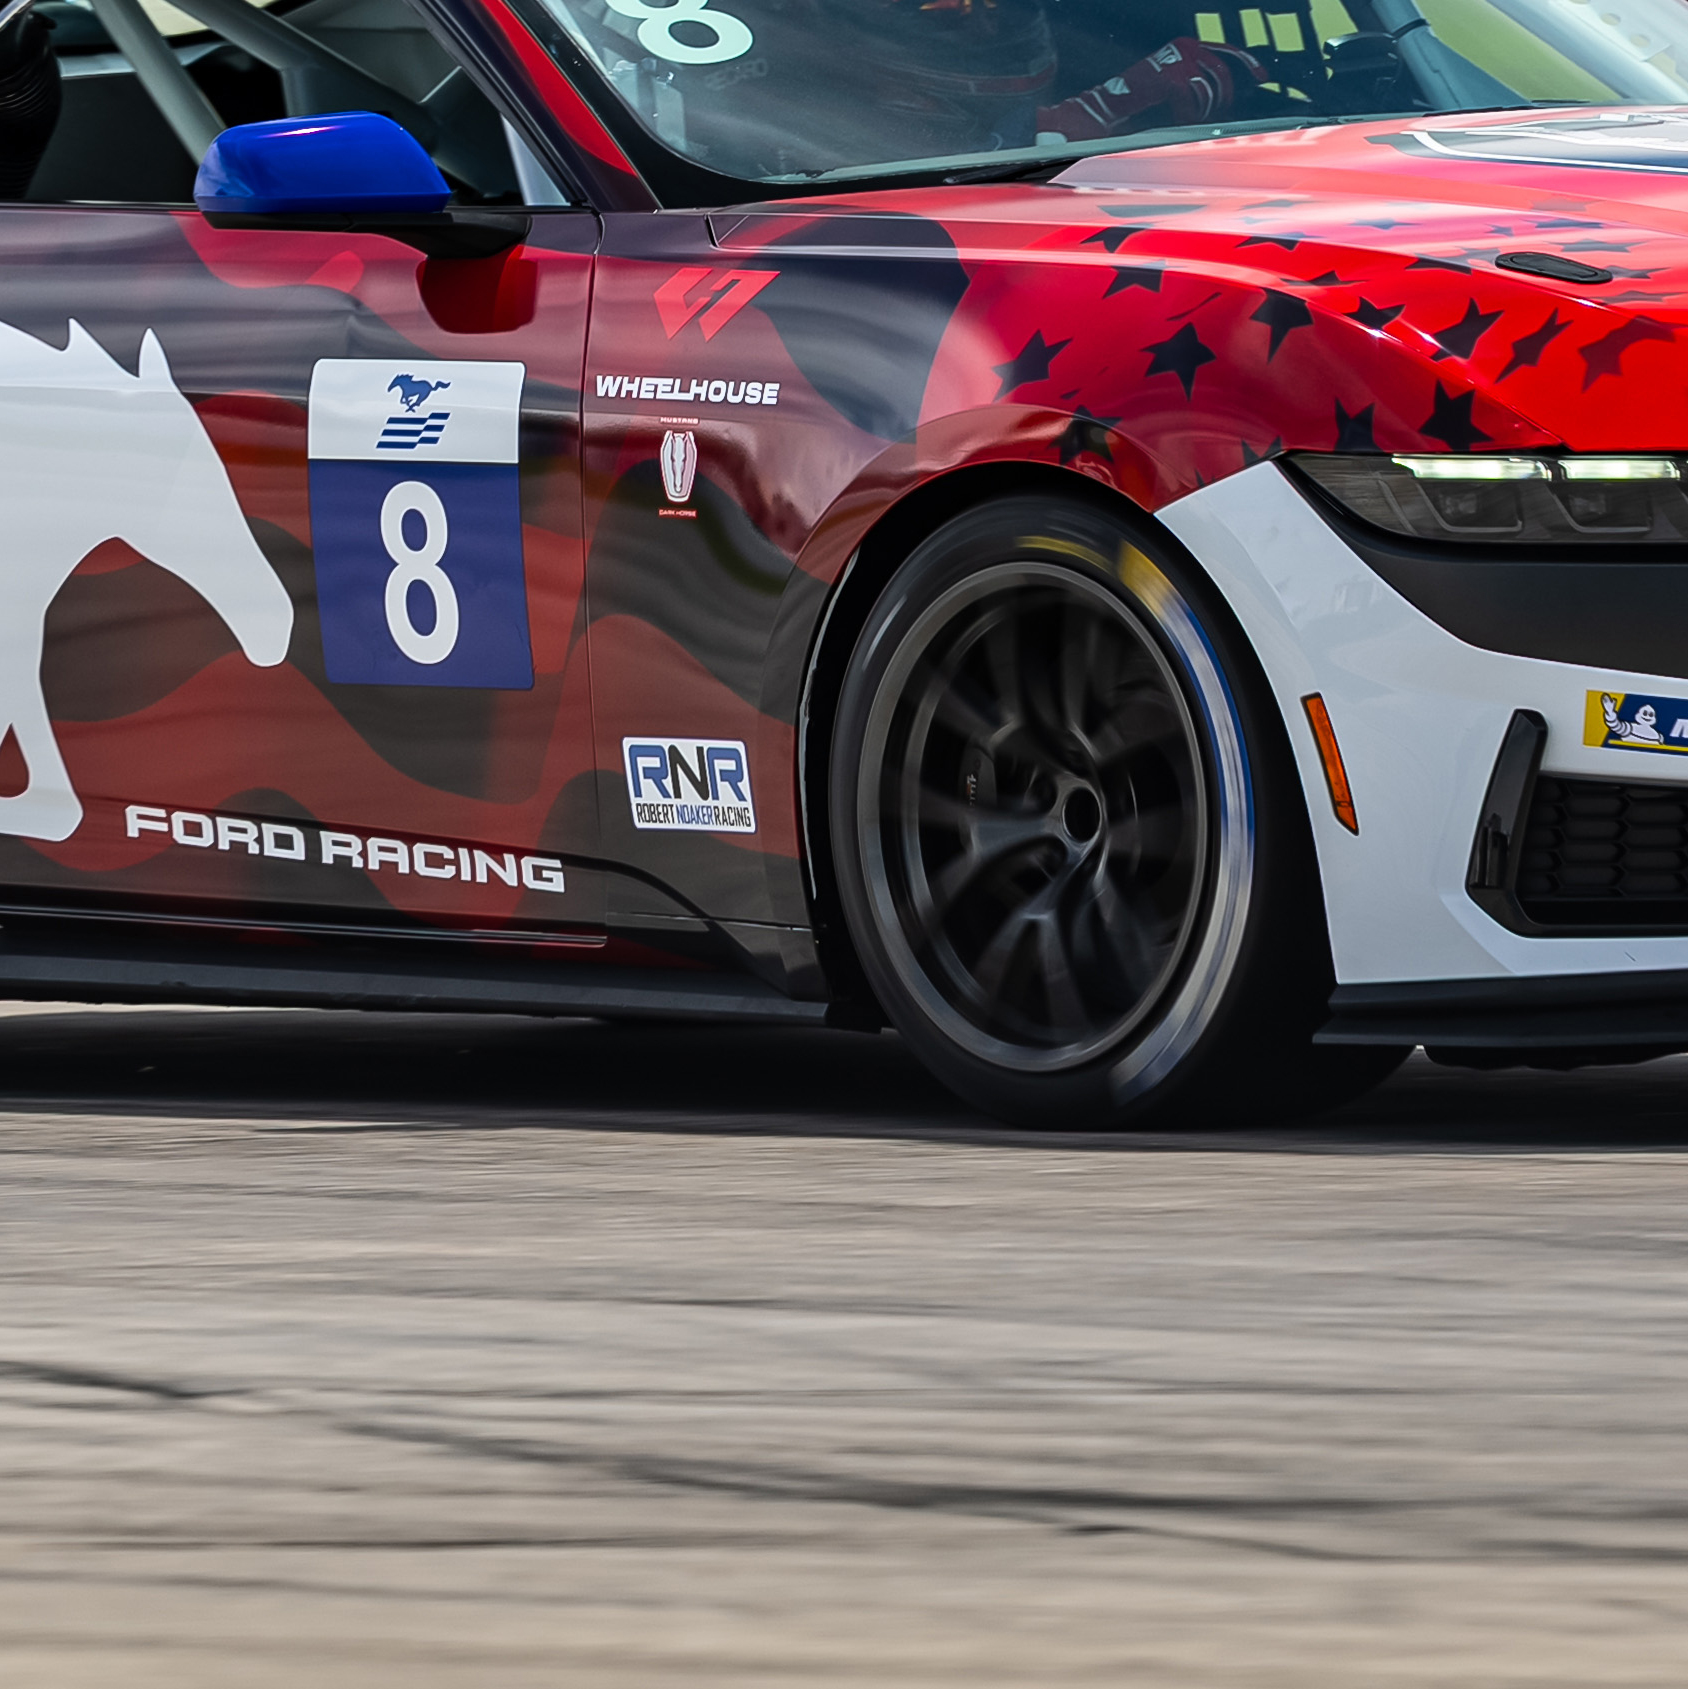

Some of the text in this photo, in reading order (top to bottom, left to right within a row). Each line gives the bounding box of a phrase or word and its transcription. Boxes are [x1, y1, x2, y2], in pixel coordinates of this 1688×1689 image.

[596, 375, 780, 405] WHEELHOUSE
[660, 416, 699, 425] MUSTANG
[380, 480, 460, 664] 8
[628, 744, 748, 802] RNR
[635, 802, 752, 827] ROBERT NOAKER RACING
[124, 805, 565, 893] FORD RACING
